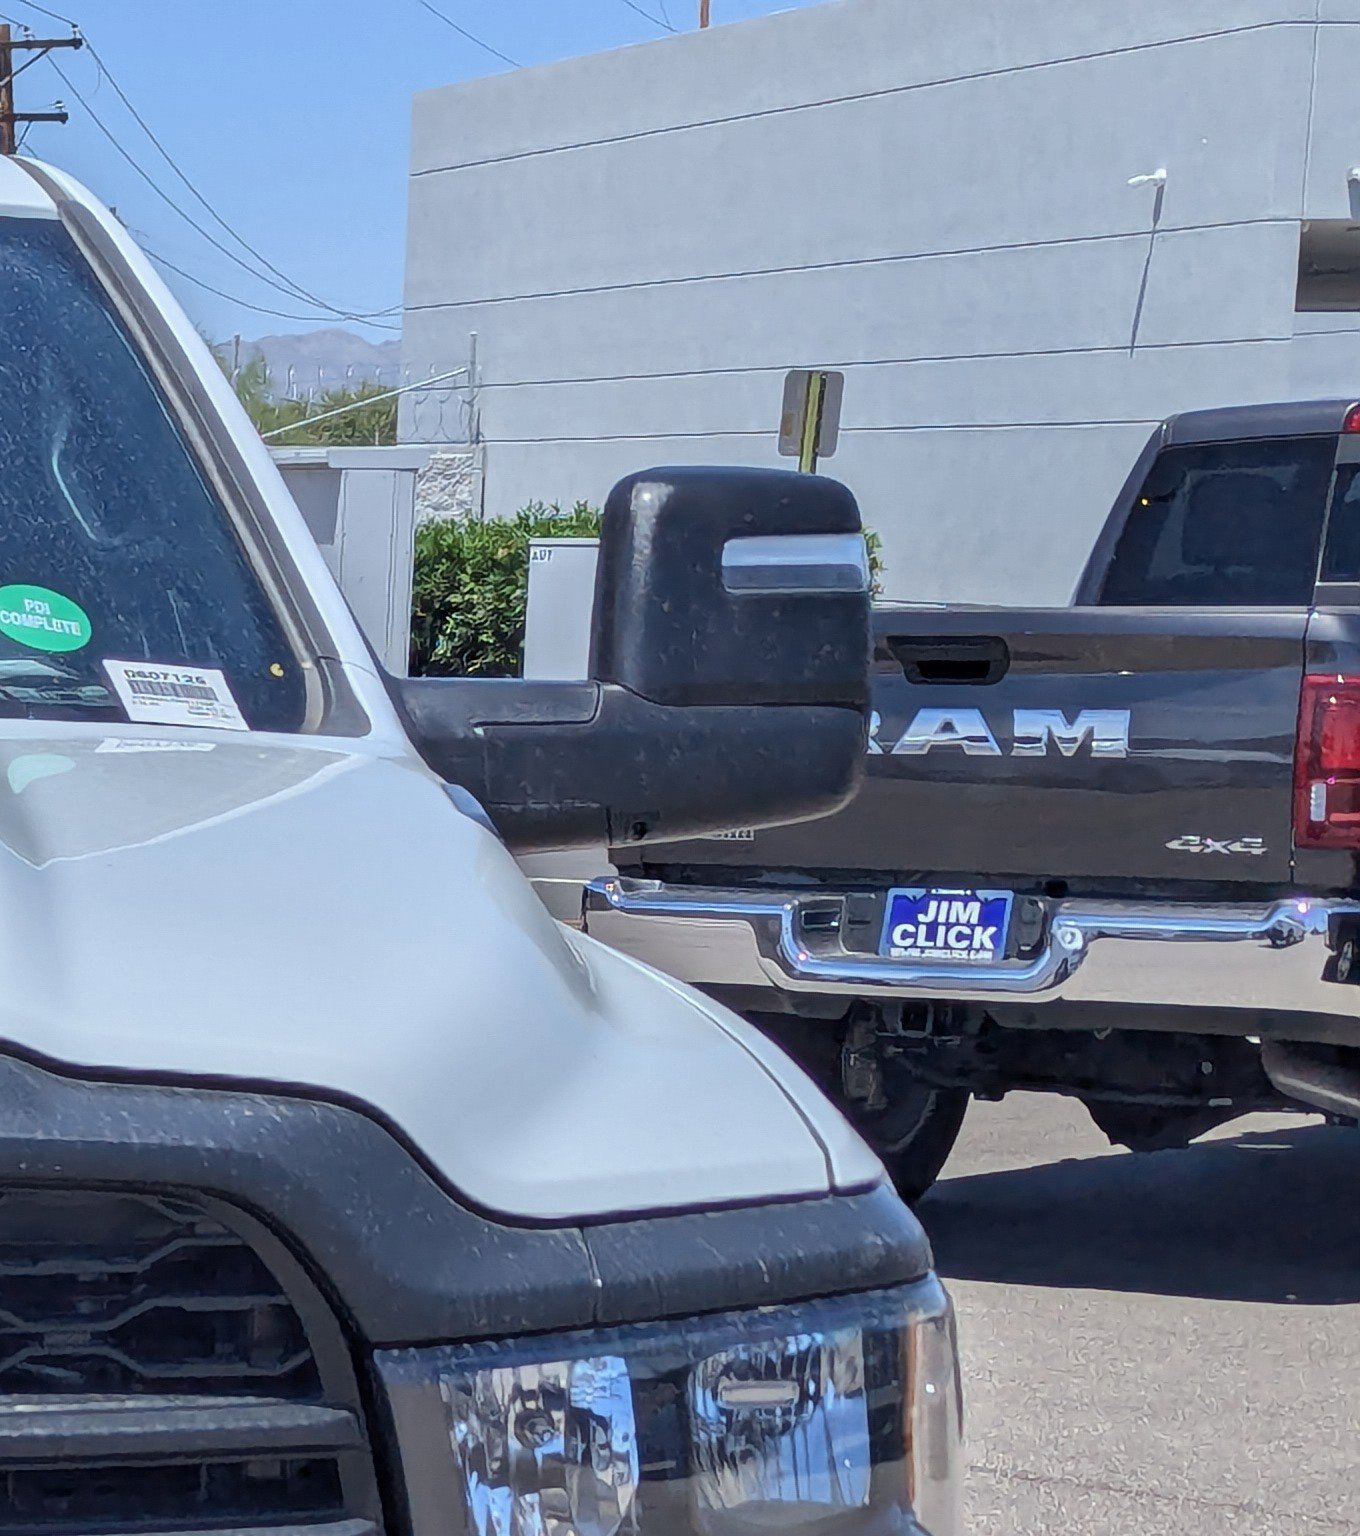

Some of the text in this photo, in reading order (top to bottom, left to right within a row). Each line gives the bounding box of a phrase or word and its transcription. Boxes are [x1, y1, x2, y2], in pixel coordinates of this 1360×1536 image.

[24, 598, 51, 615] PDI
[0, 610, 82, 636] COMPLETE
[917, 900, 981, 925] JIM
[892, 923, 998, 950] CLICK
